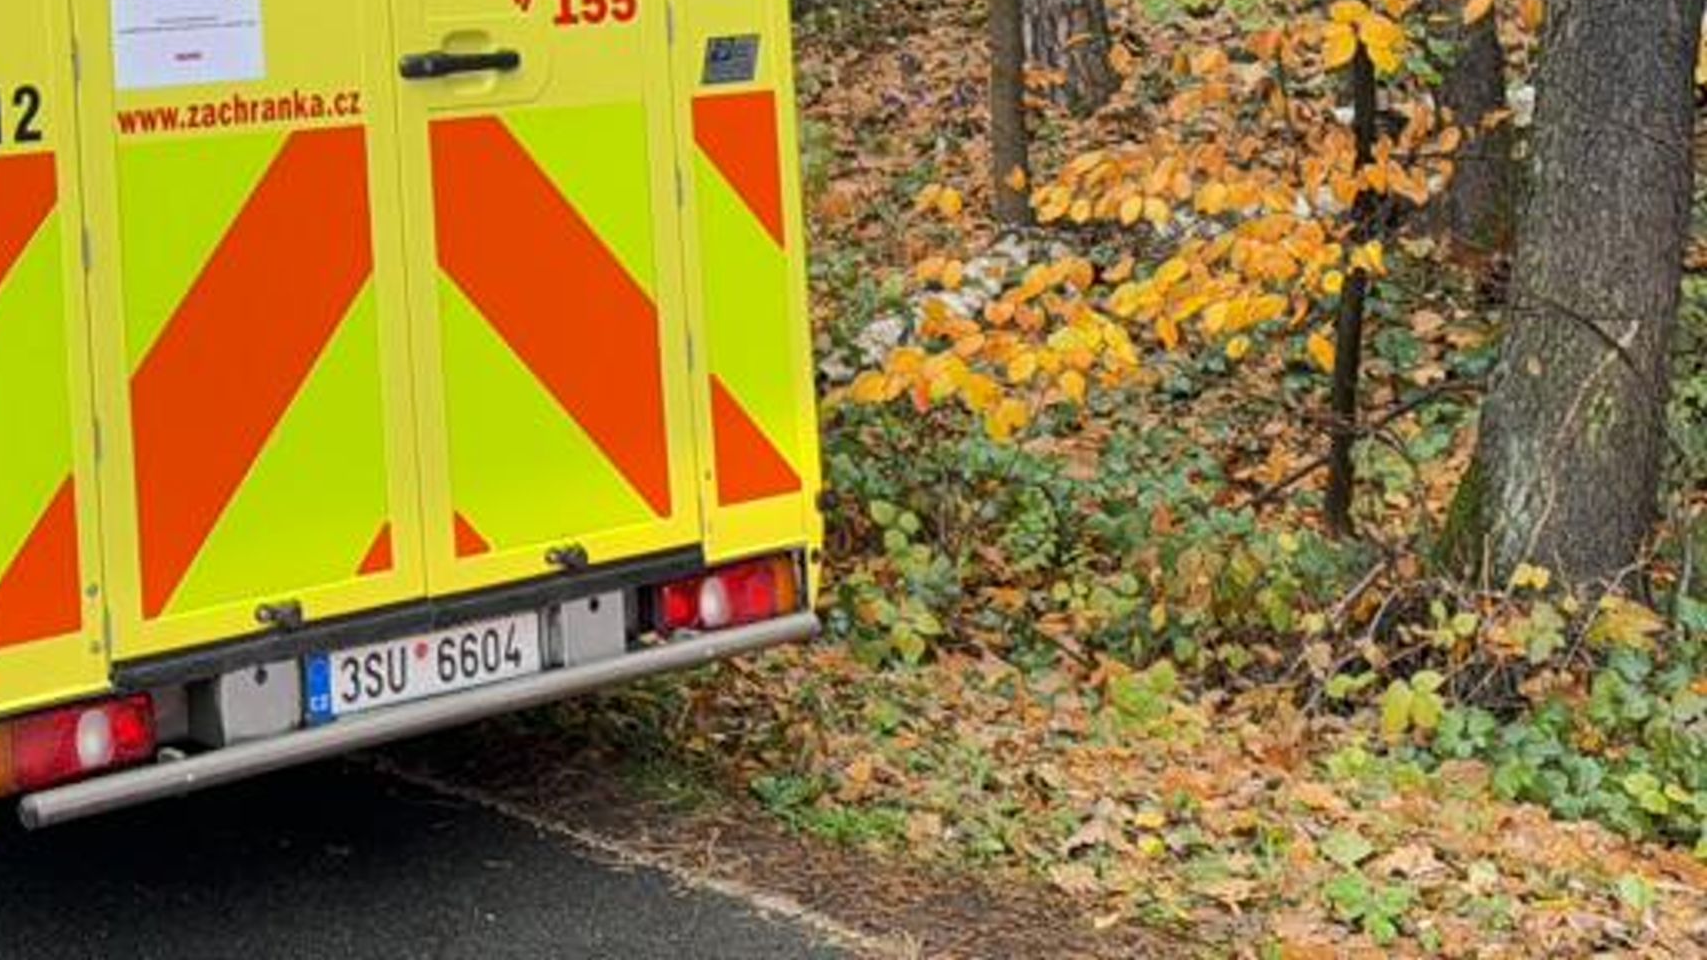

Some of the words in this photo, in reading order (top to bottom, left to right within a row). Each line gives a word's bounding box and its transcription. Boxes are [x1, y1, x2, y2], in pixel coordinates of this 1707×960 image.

[116, 89, 362, 135] www.zachranka.cz
[340, 645, 407, 703] 3SU
[436, 621, 522, 683] 6604
